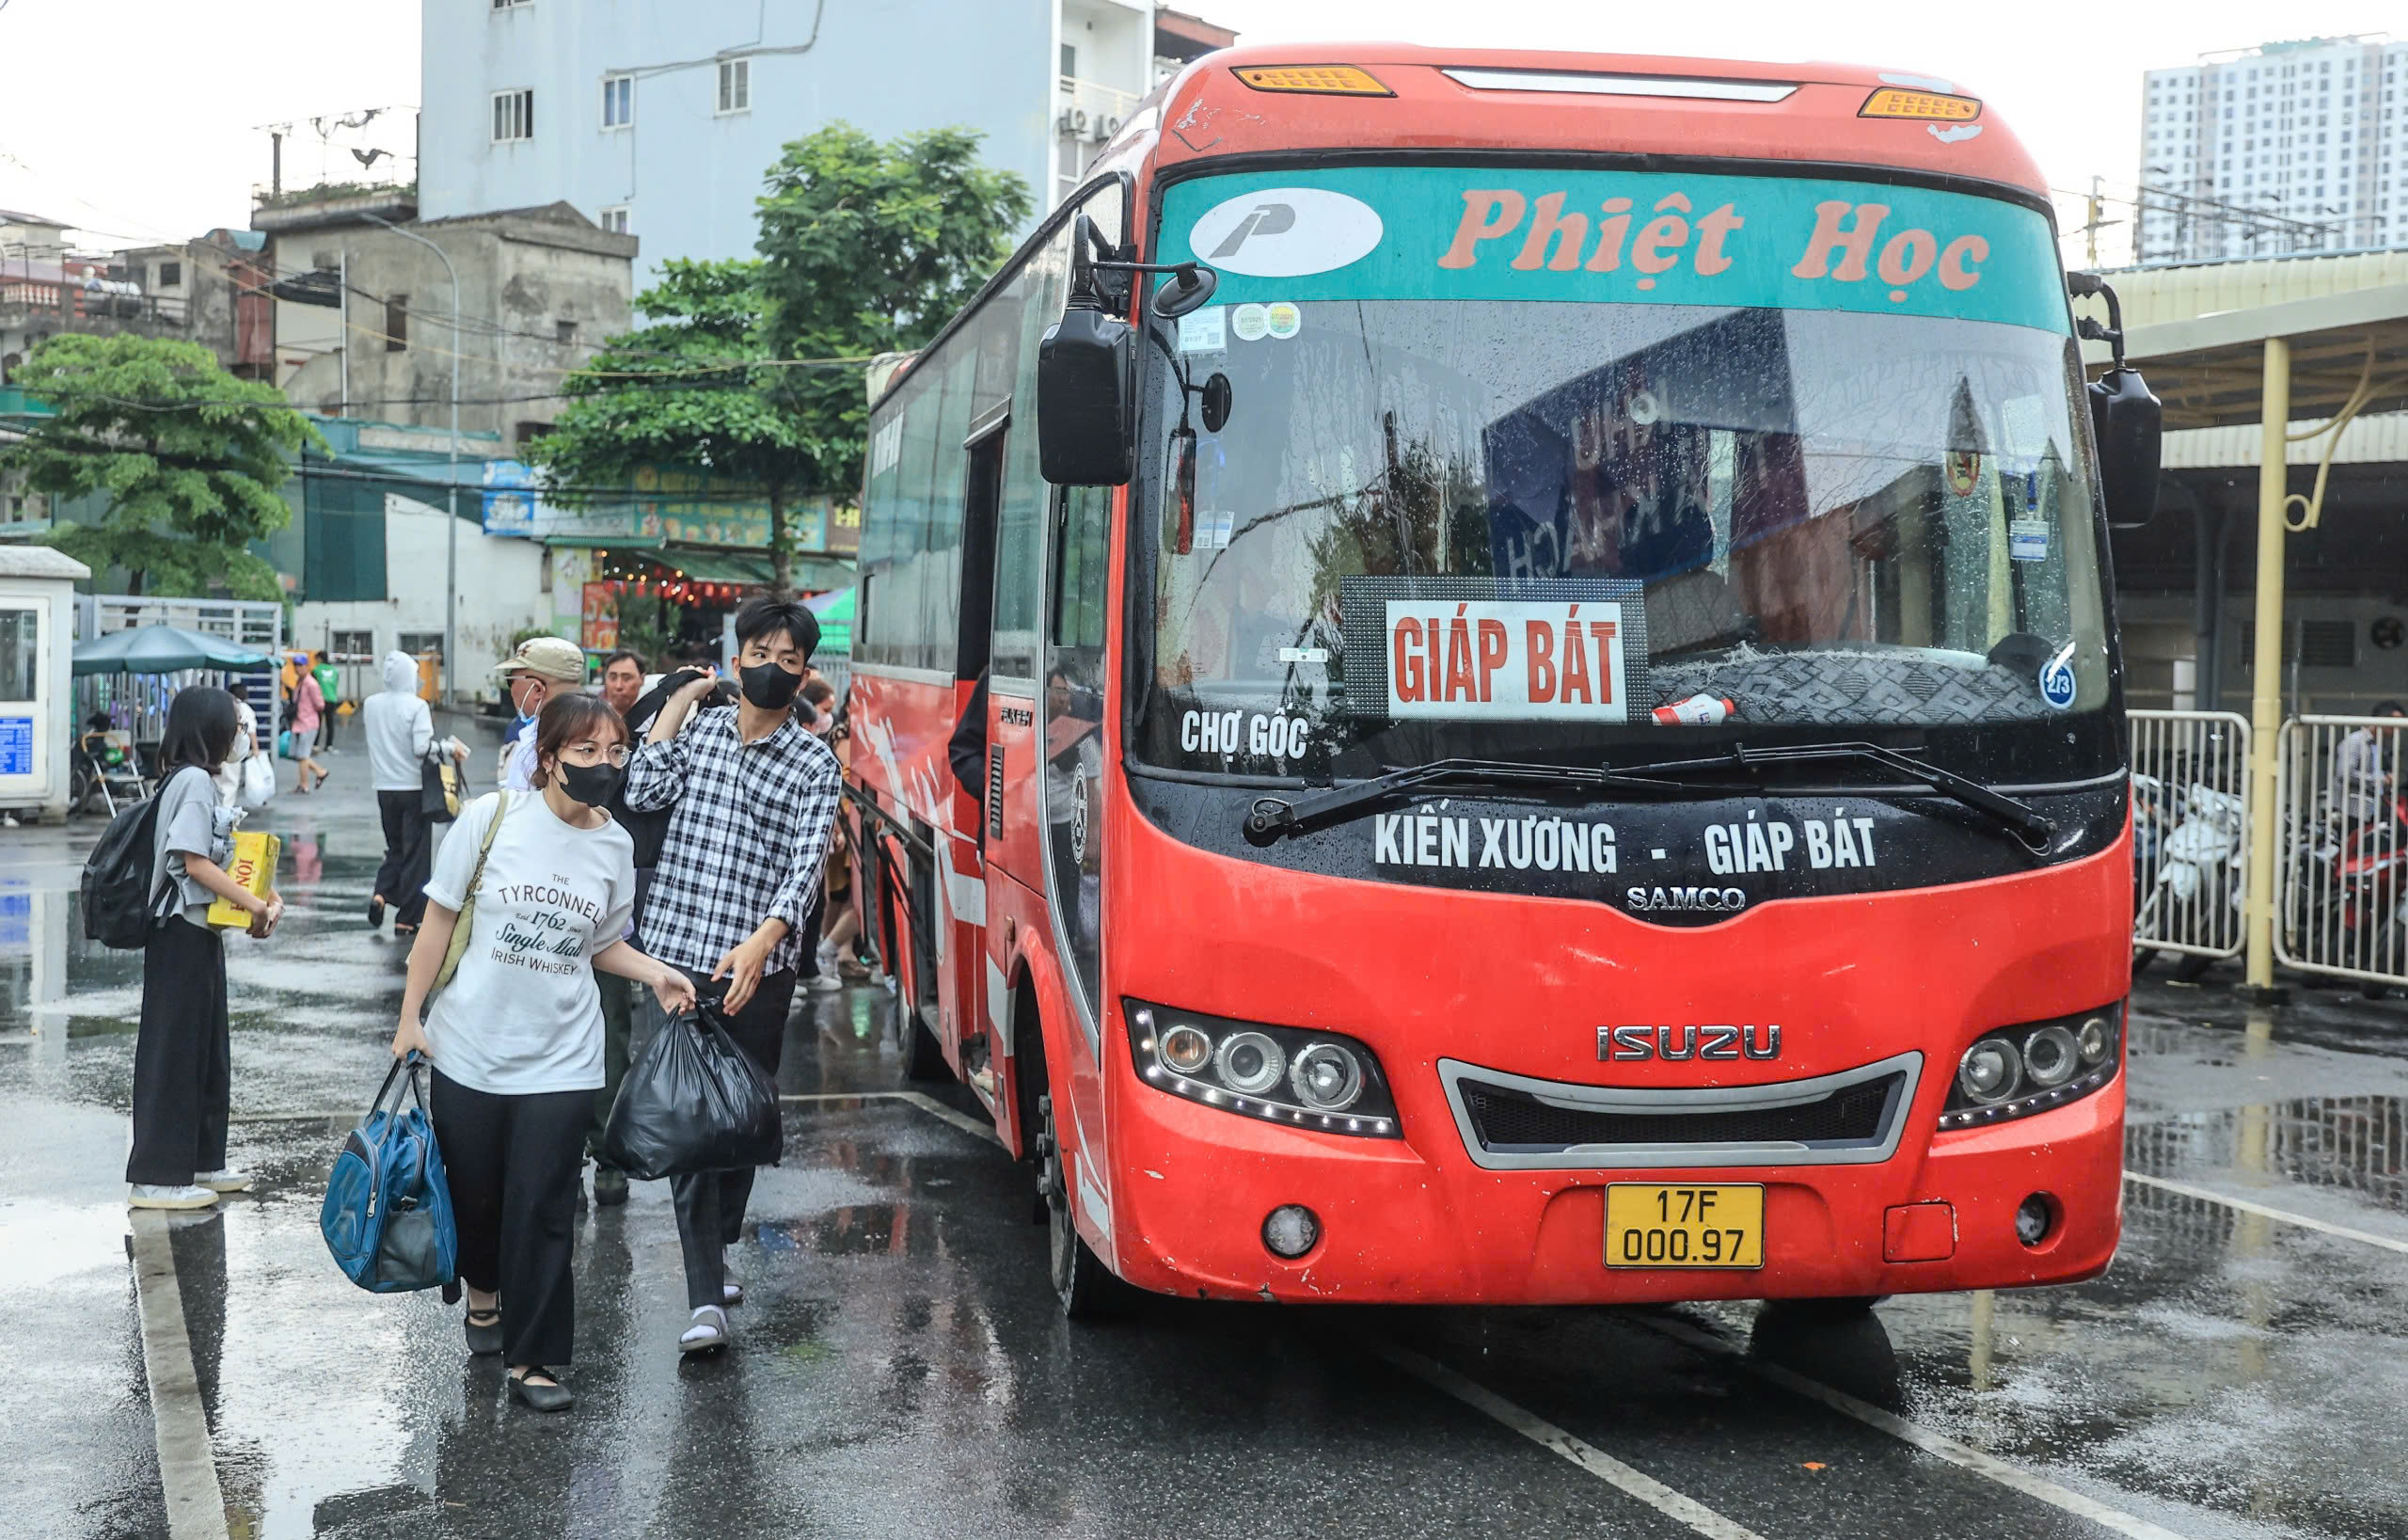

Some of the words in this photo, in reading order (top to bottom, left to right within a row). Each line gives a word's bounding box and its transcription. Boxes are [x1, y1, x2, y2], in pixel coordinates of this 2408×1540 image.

[1437, 189, 1745, 291] Phiệt
[1791, 200, 1990, 303] Học
[1394, 603, 1508, 704] GIÁP
[1526, 604, 1617, 705] BÁT
[1181, 709, 1243, 762] CHỢ
[1249, 702, 1308, 759] GỐC
[1375, 799, 1469, 867] KIẾN
[1479, 815, 1617, 873] XƯƠNG
[1703, 807, 1794, 875] GIÁP
[1804, 806, 1877, 869] BÁT
[552, 873, 571, 885] THE
[1626, 886, 1746, 911] SAMCO
[496, 922, 548, 952] Single
[531, 911, 567, 930] 1762
[491, 946, 525, 966] IRISH
[530, 959, 578, 976] WHISKEY
[1596, 1024, 1782, 1061] ISUZU
[1657, 1190, 1719, 1223] 17F
[1624, 1229, 1745, 1262] 000.97
